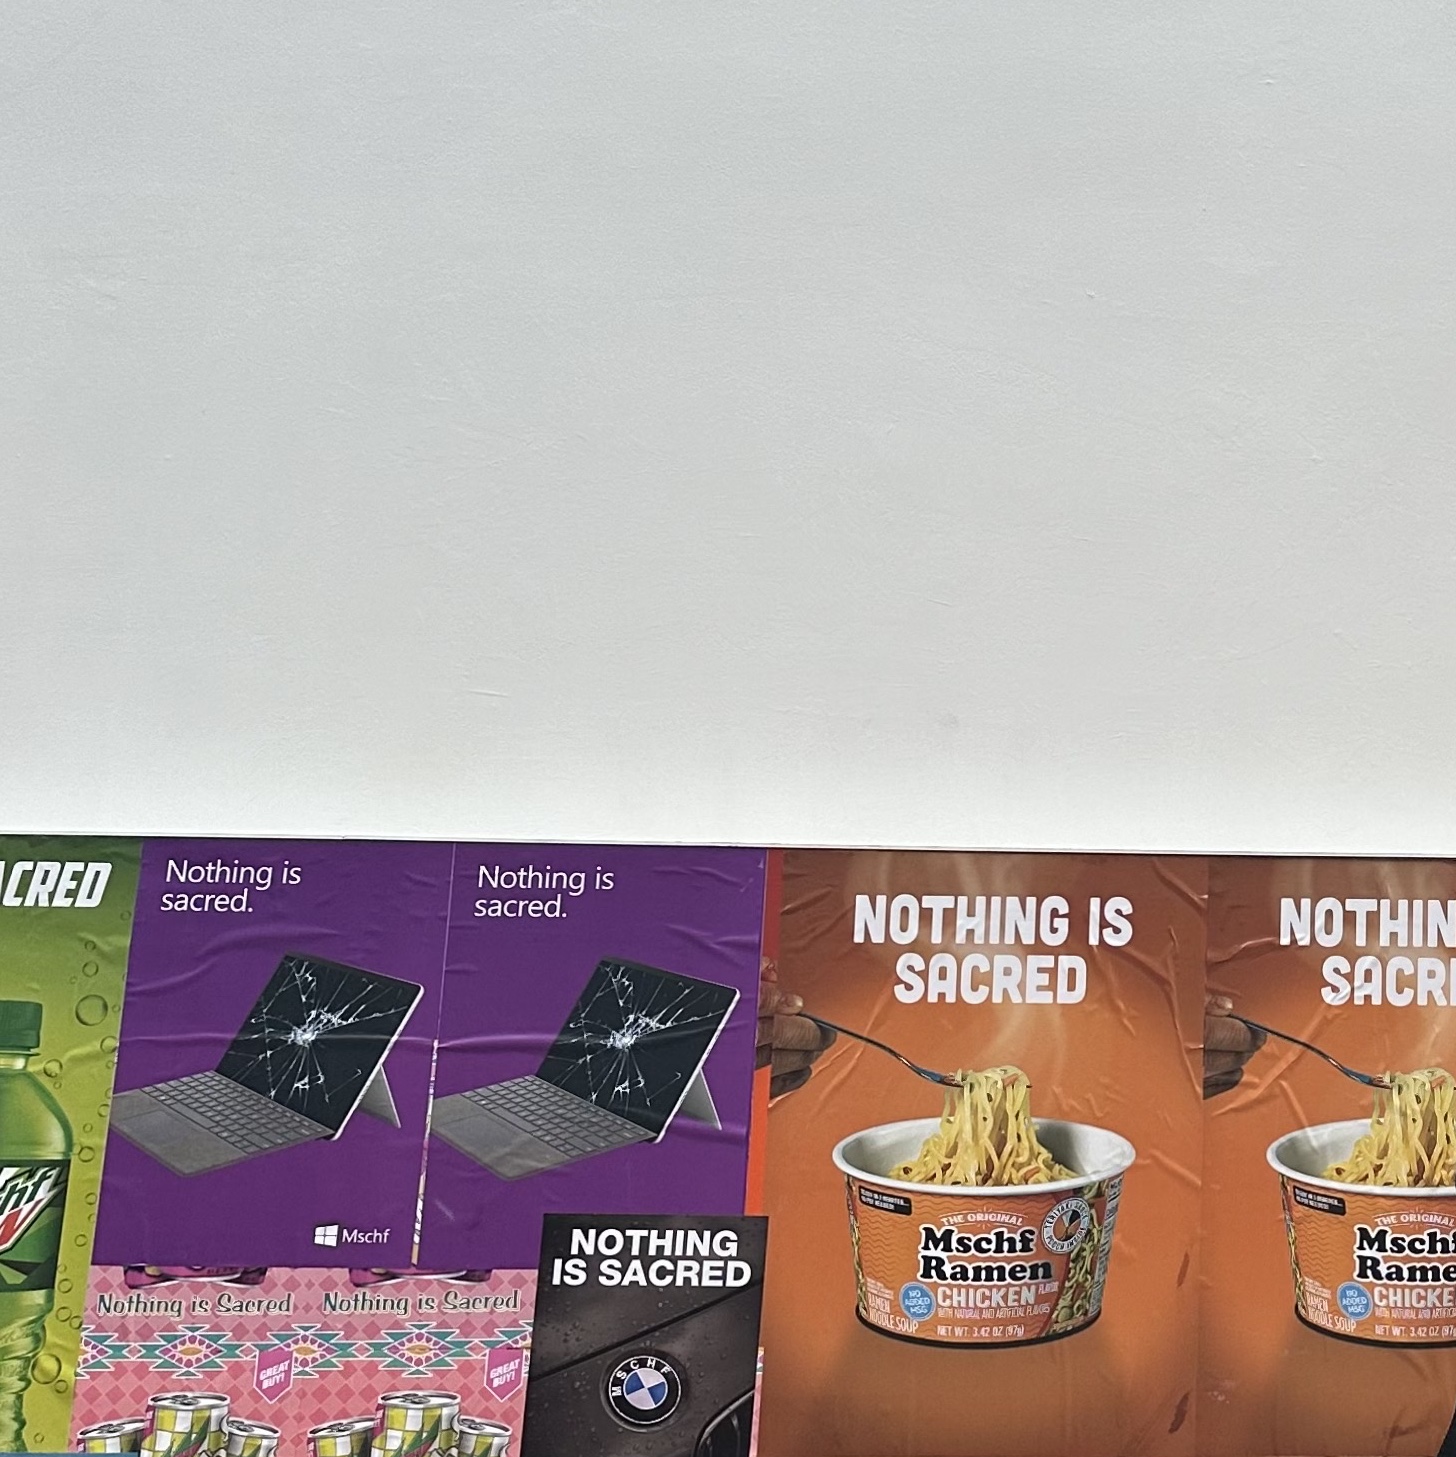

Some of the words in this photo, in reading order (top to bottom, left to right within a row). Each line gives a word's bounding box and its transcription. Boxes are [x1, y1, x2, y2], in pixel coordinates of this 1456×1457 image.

[0, 861, 112, 907] CRED
[166, 859, 272, 890] Nothing
[283, 861, 301, 884] is
[479, 865, 585, 896] Nothing
[596, 867, 613, 889] is
[161, 888, 252, 912] sacred.
[474, 894, 566, 917] sacred.
[854, 894, 1068, 946] NOTHING
[1089, 897, 1132, 946] IS
[894, 953, 1086, 1004] SACRED
[941, 1215, 964, 1225] THE
[1375, 1216, 1397, 1225] THE
[1400, 1214, 1454, 1226] ORIGINAL
[342, 1229, 390, 1243] Mschf
[571, 1229, 737, 1256] NOTHING
[922, 1227, 1035, 1254] Mschf
[553, 1259, 594, 1286] IS
[599, 1259, 751, 1287] SACRED
[920, 1255, 1053, 1282] Ramen
[98, 1294, 182, 1319] Nothing
[192, 1293, 213, 1313] is
[216, 1293, 291, 1312] Sacred
[324, 1292, 408, 1315] Nothing
[417, 1291, 438, 1311] is
[443, 1290, 518, 1309] Sacred
[937, 1285, 1035, 1308] CHICKEN
[611, 1357, 671, 1397] MSCHF
